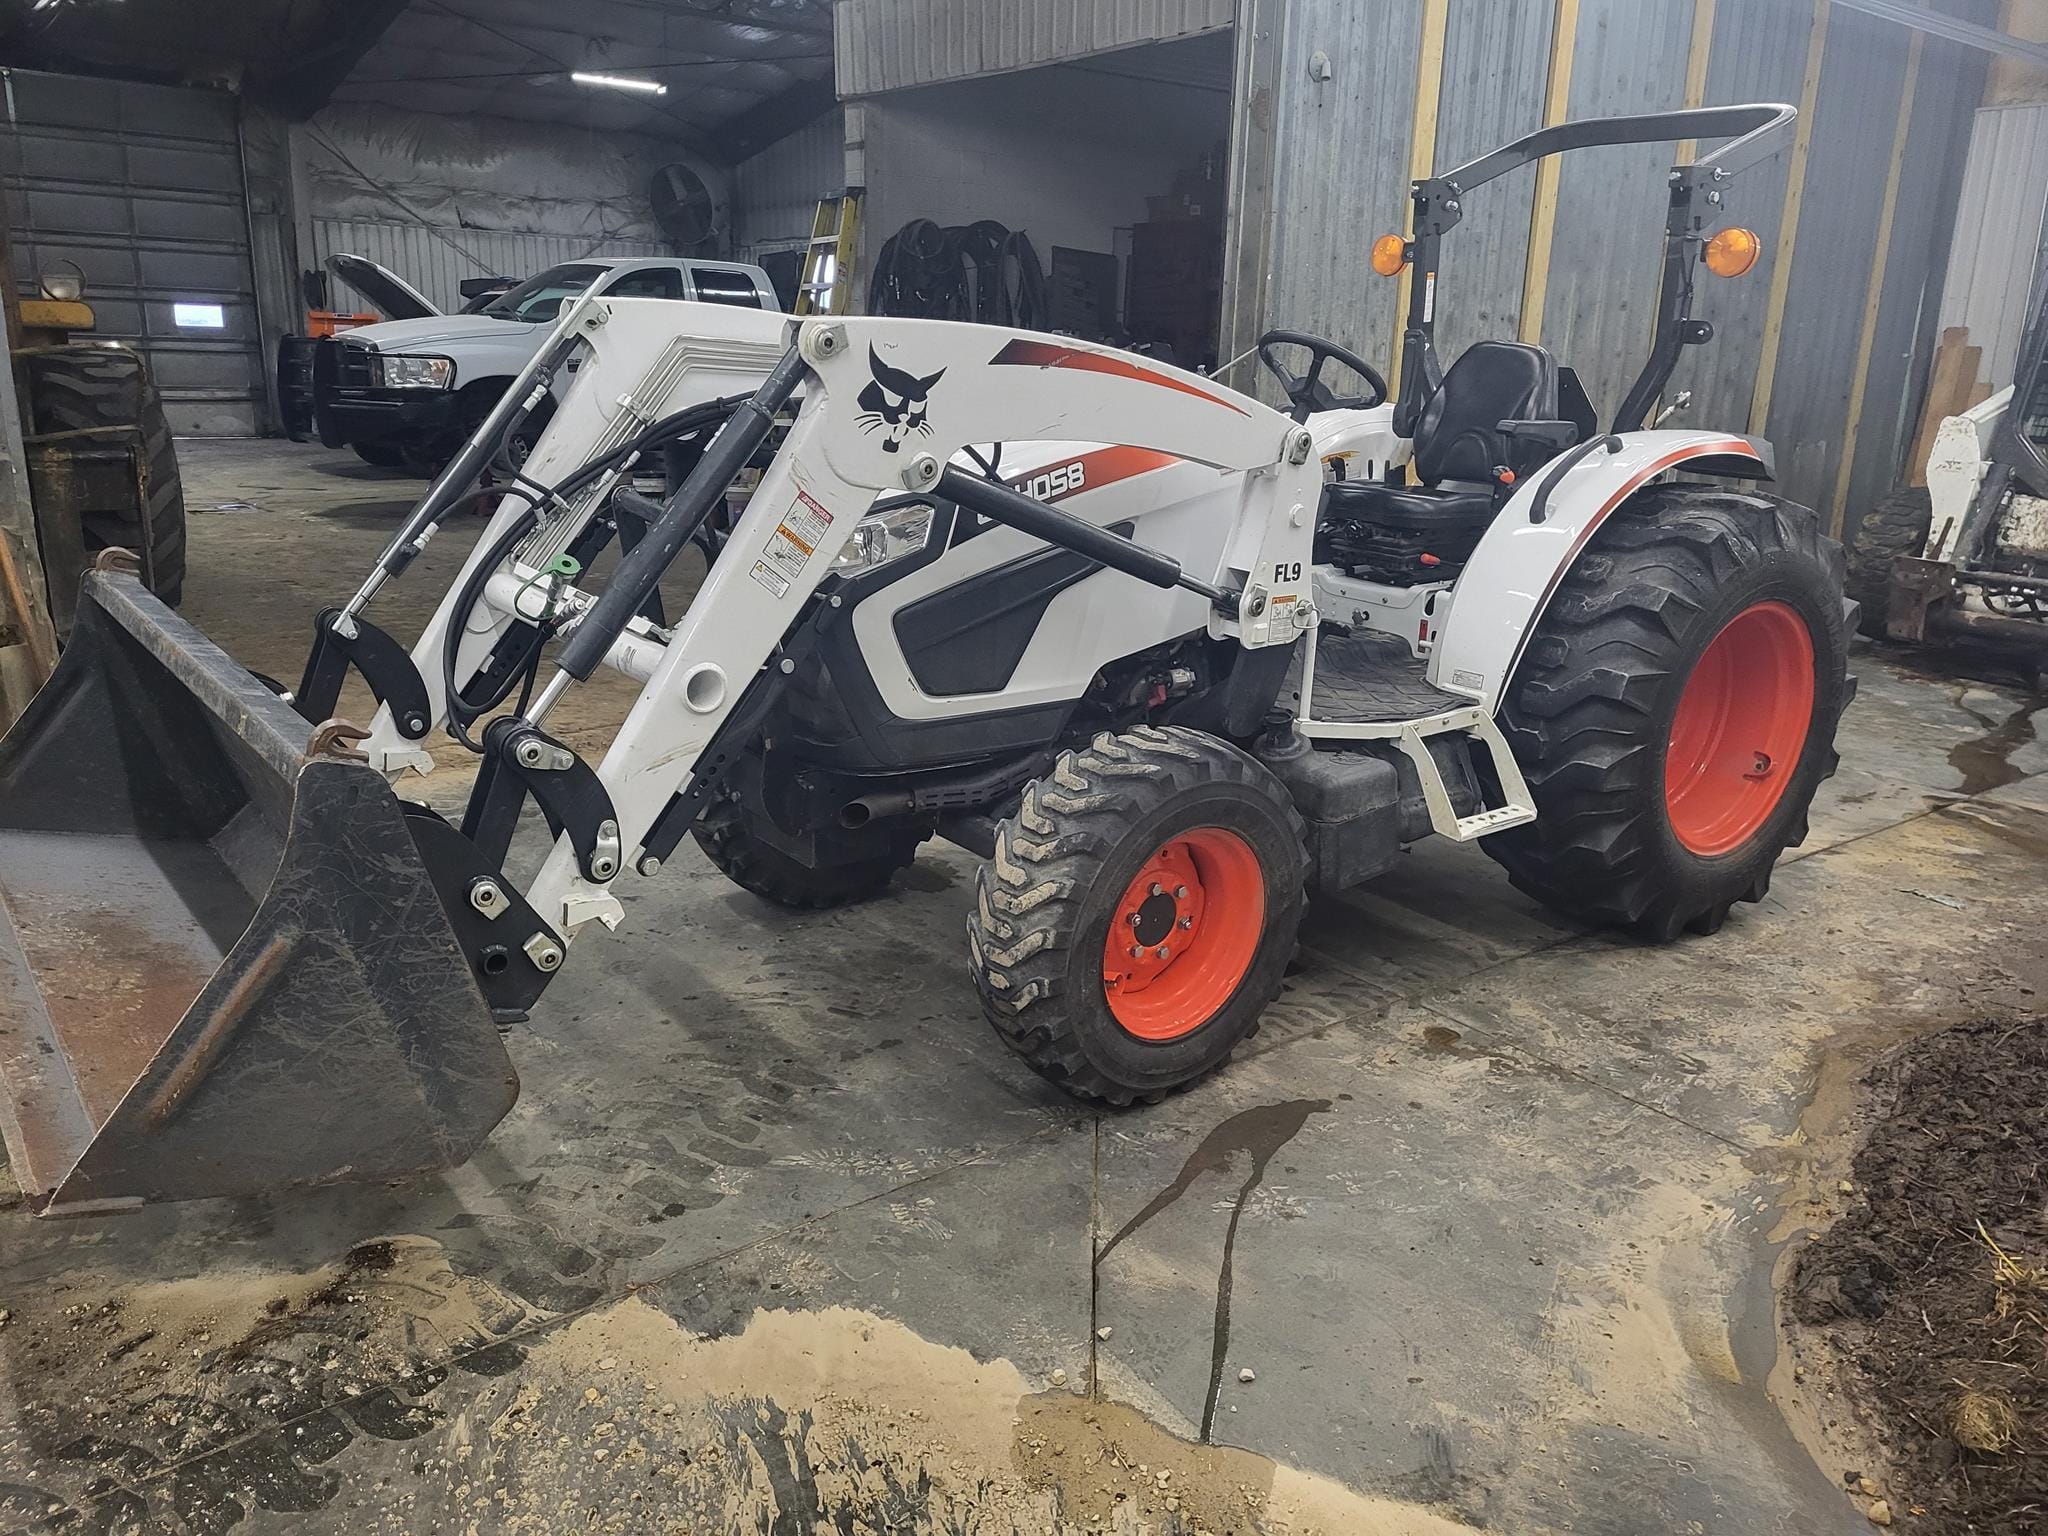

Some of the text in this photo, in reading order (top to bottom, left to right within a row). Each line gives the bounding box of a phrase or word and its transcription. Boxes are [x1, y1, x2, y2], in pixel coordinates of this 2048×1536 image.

[806, 501, 831, 521] DANGER
[786, 532, 810, 553] WARNING
[1274, 562, 1302, 584] FL9
